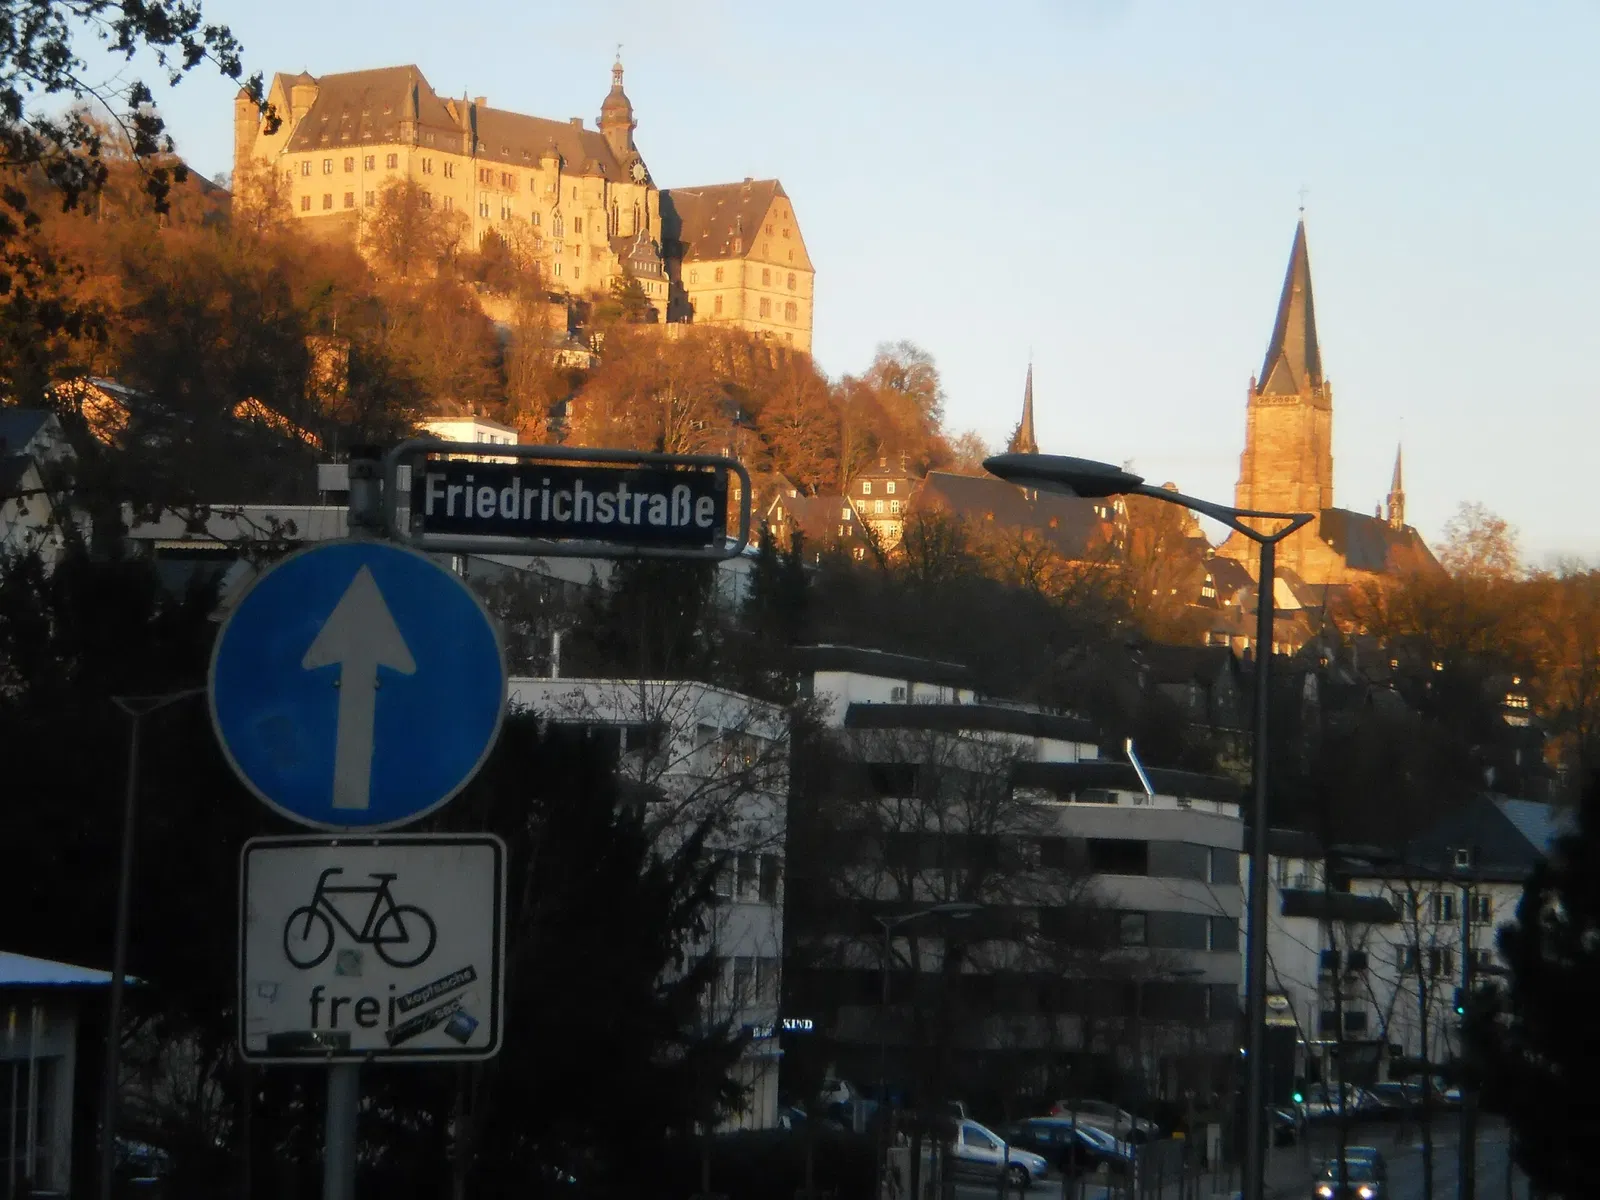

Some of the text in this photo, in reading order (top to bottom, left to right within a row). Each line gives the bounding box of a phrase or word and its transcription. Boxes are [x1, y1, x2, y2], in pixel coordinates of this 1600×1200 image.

[425, 473, 715, 528] Friedrichstraße
[309, 984, 397, 1029] frei
[782, 1018, 814, 1030] KIND
